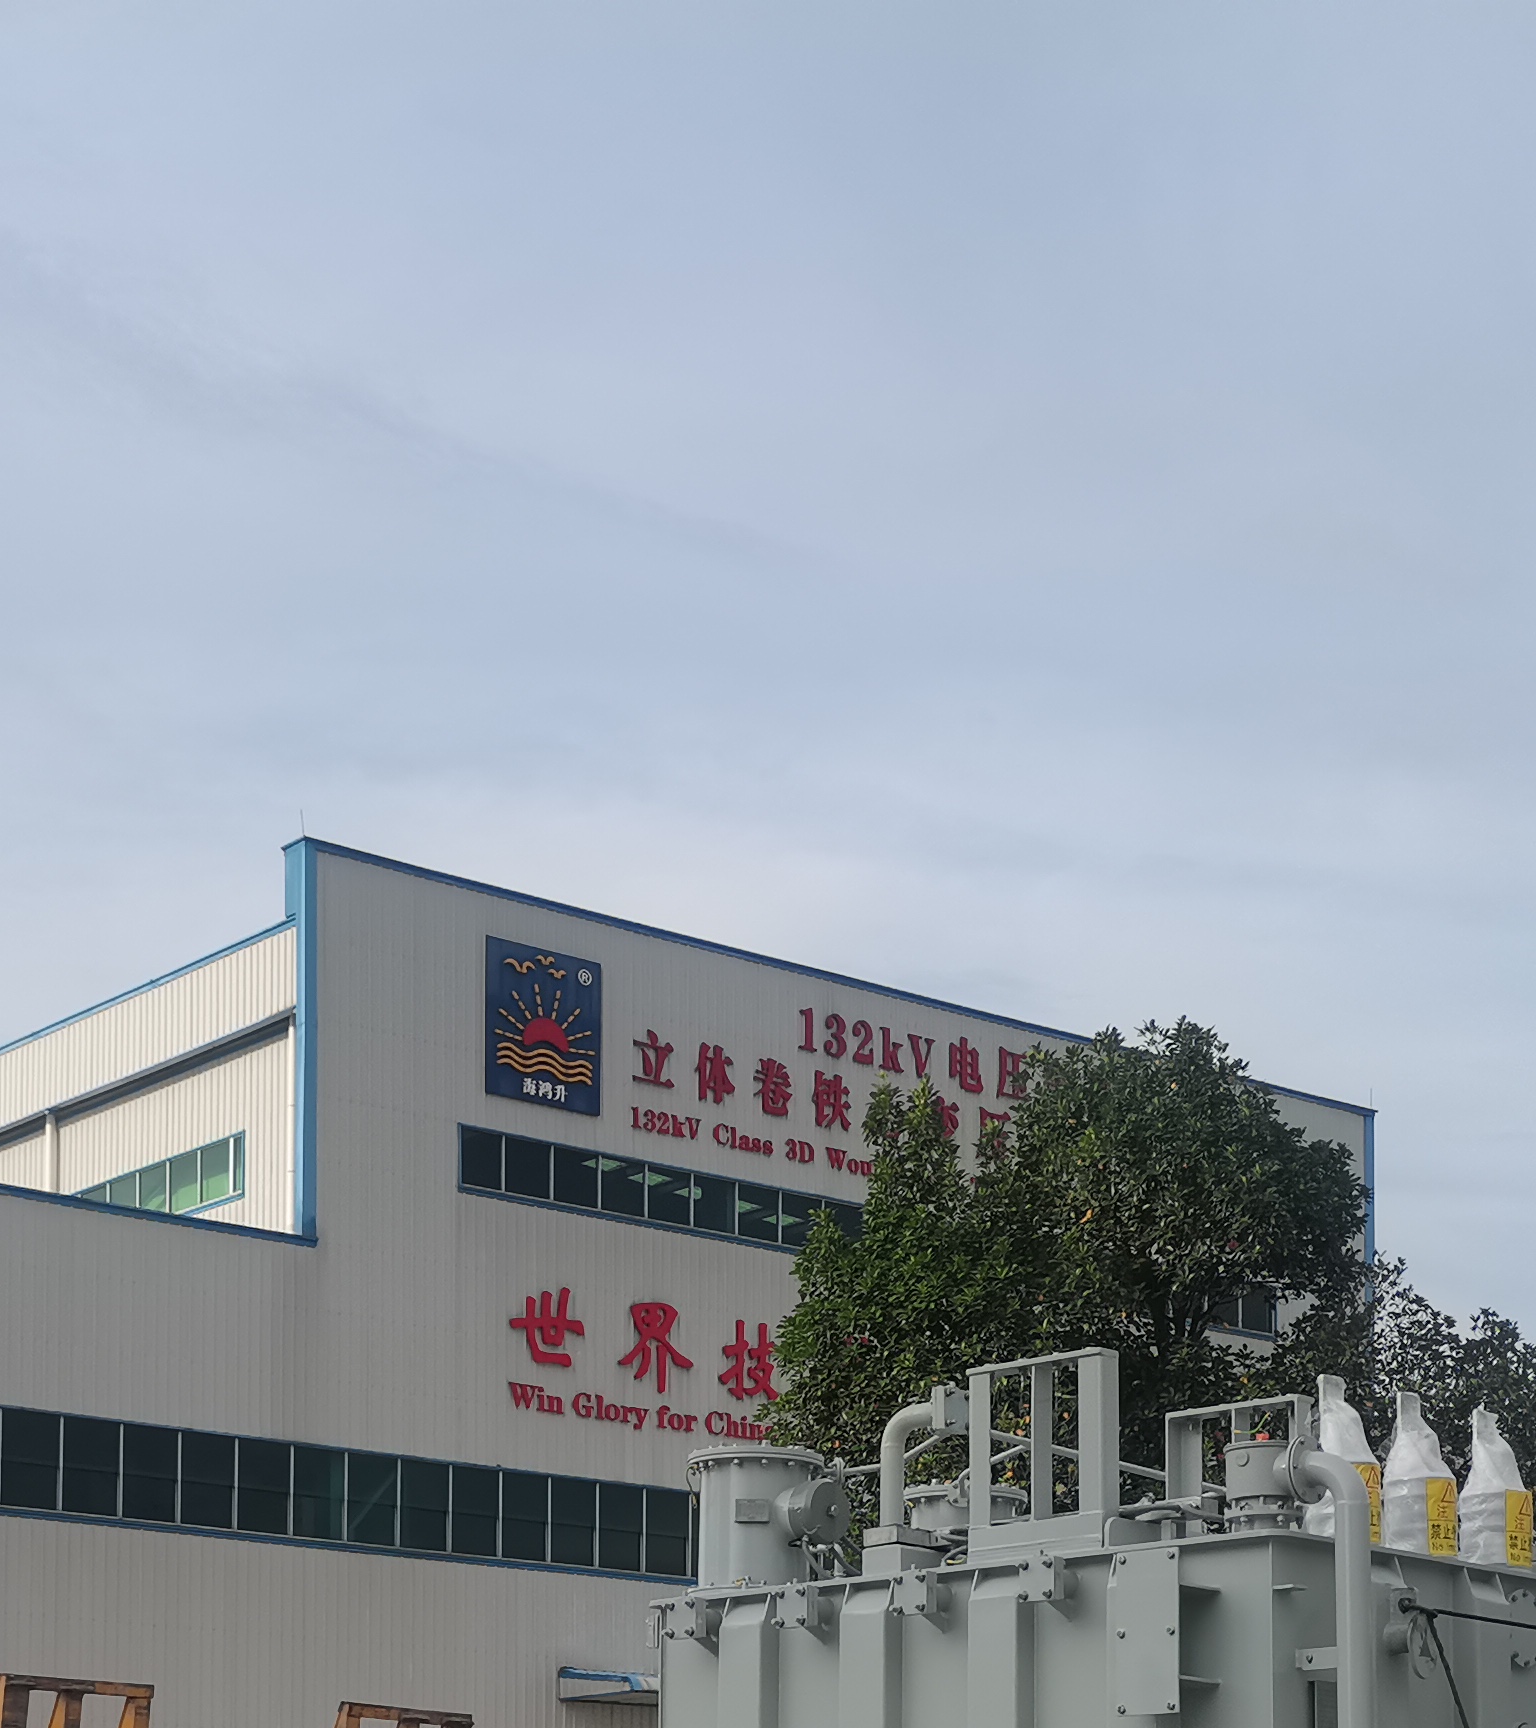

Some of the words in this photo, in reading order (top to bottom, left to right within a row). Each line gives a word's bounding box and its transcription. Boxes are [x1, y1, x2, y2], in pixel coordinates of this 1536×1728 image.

[630, 1106, 701, 1140] 132kV
[712, 1123, 774, 1157] Class
[785, 1139, 815, 1164] 3D
[825, 1146, 874, 1177] Wou
[508, 1381, 564, 1415] Win
[572, 1392, 649, 1430] Glory
[656, 1405, 698, 1433] for
